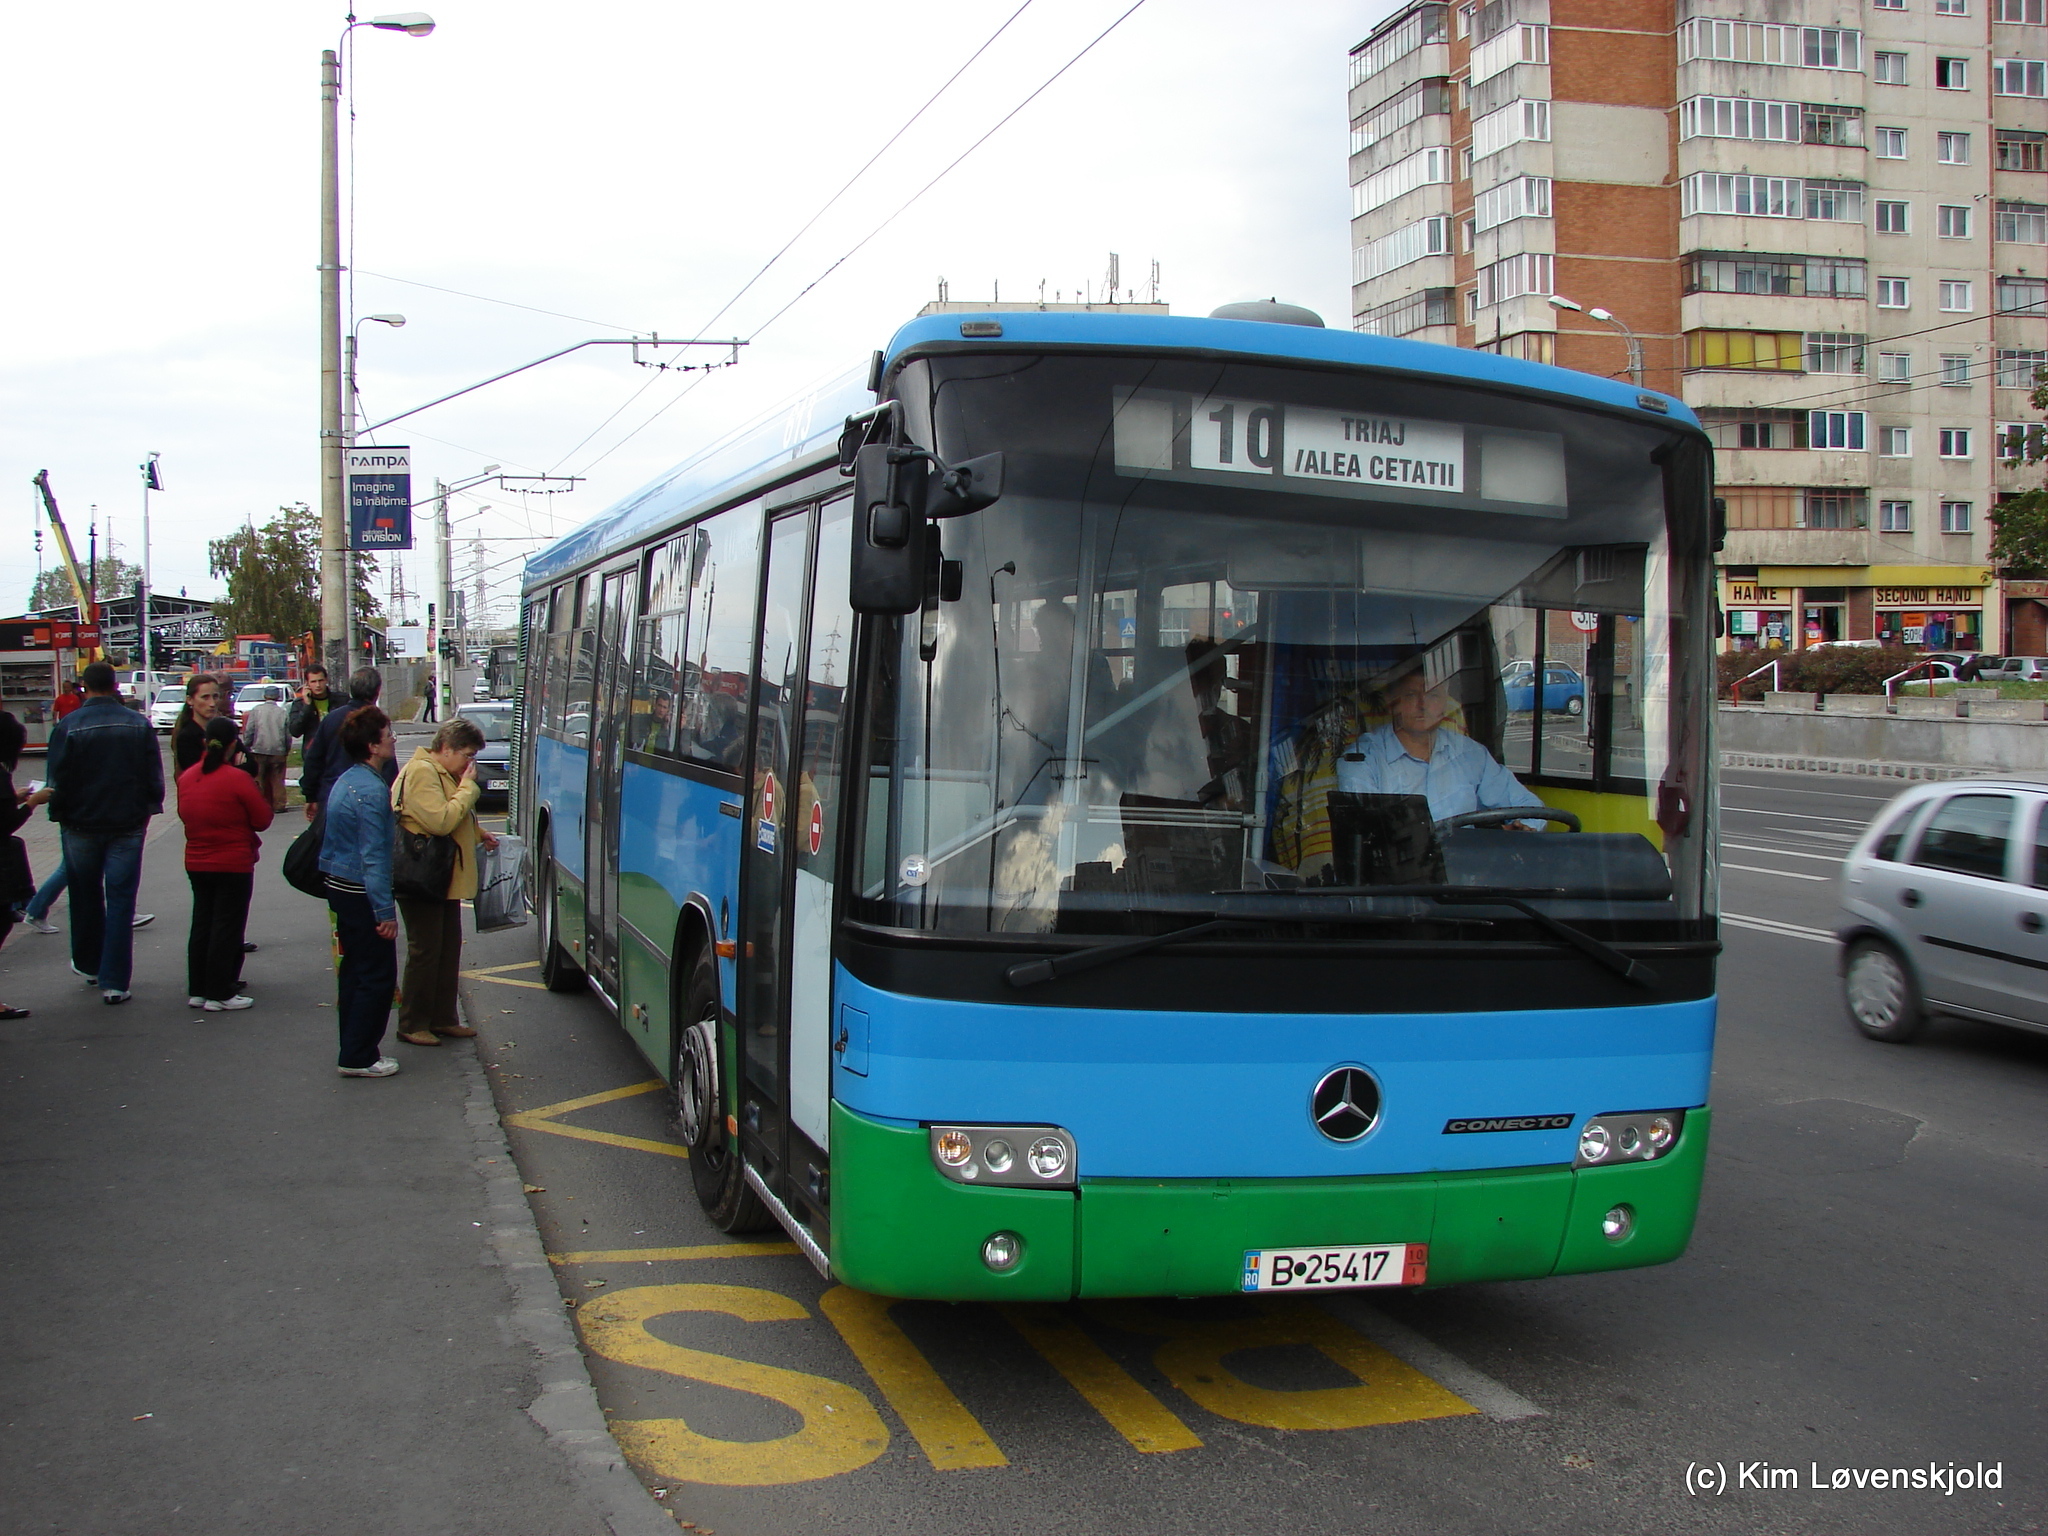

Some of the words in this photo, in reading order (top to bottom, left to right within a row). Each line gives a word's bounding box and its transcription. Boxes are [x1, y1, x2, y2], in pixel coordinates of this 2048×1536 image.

[1208, 403, 1274, 468] 10
[1340, 417, 1405, 446] TRIAJ
[1294, 448, 1362, 478] /ALEA
[1369, 455, 1454, 487] CETATII
[352, 482, 395, 494] Imagine
[352, 496, 362, 506] la
[362, 527, 402, 542] DIVISION
[1733, 585, 1777, 600] HAINE
[1876, 588, 1926, 602] SECOND
[1936, 588, 1971, 602] HAND
[1903, 628, 1924, 641] 50%
[1448, 1116, 1569, 1132] CONECTO
[1244, 1272, 1258, 1286] RO
